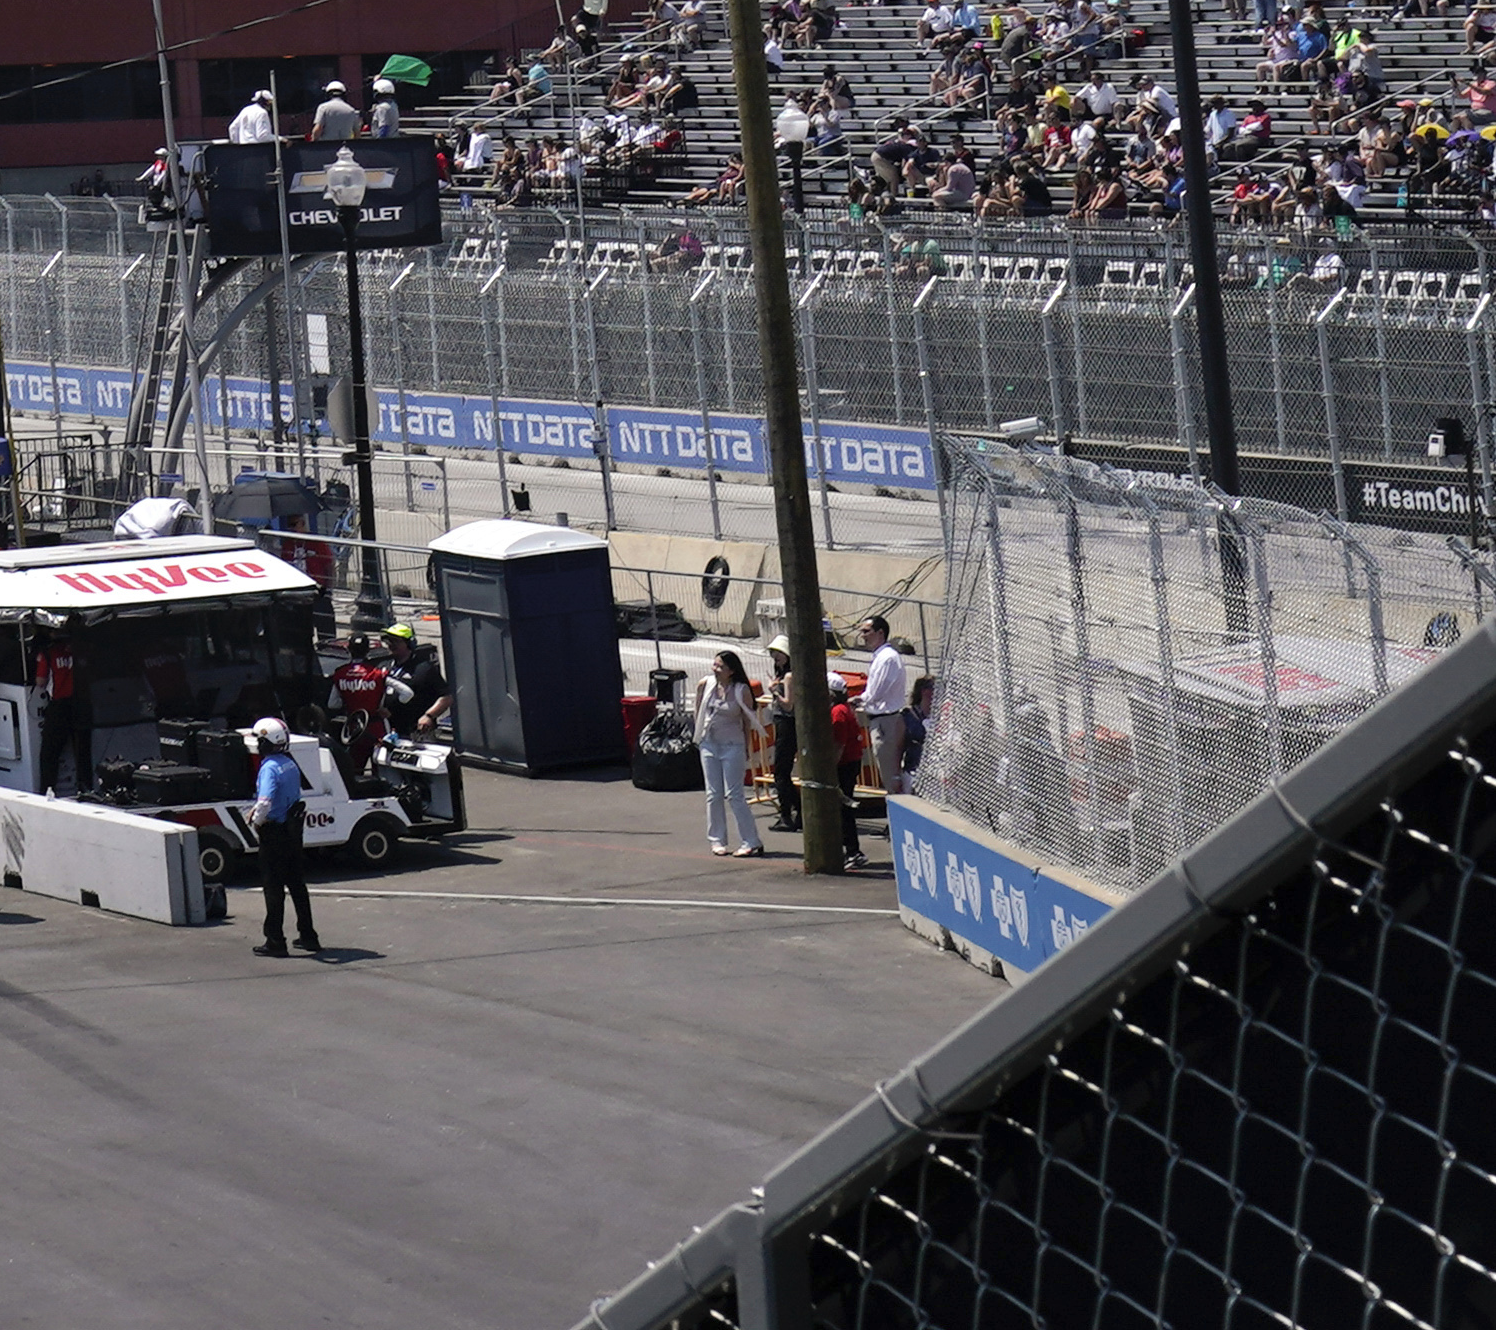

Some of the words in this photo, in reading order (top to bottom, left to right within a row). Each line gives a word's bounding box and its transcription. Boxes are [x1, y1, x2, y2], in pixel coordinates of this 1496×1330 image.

[289, 206, 403, 226] CHEVOLET
[473, 408, 526, 445] NTT
[619, 420, 675, 456] NTT
[54, 561, 268, 595] HyVee
